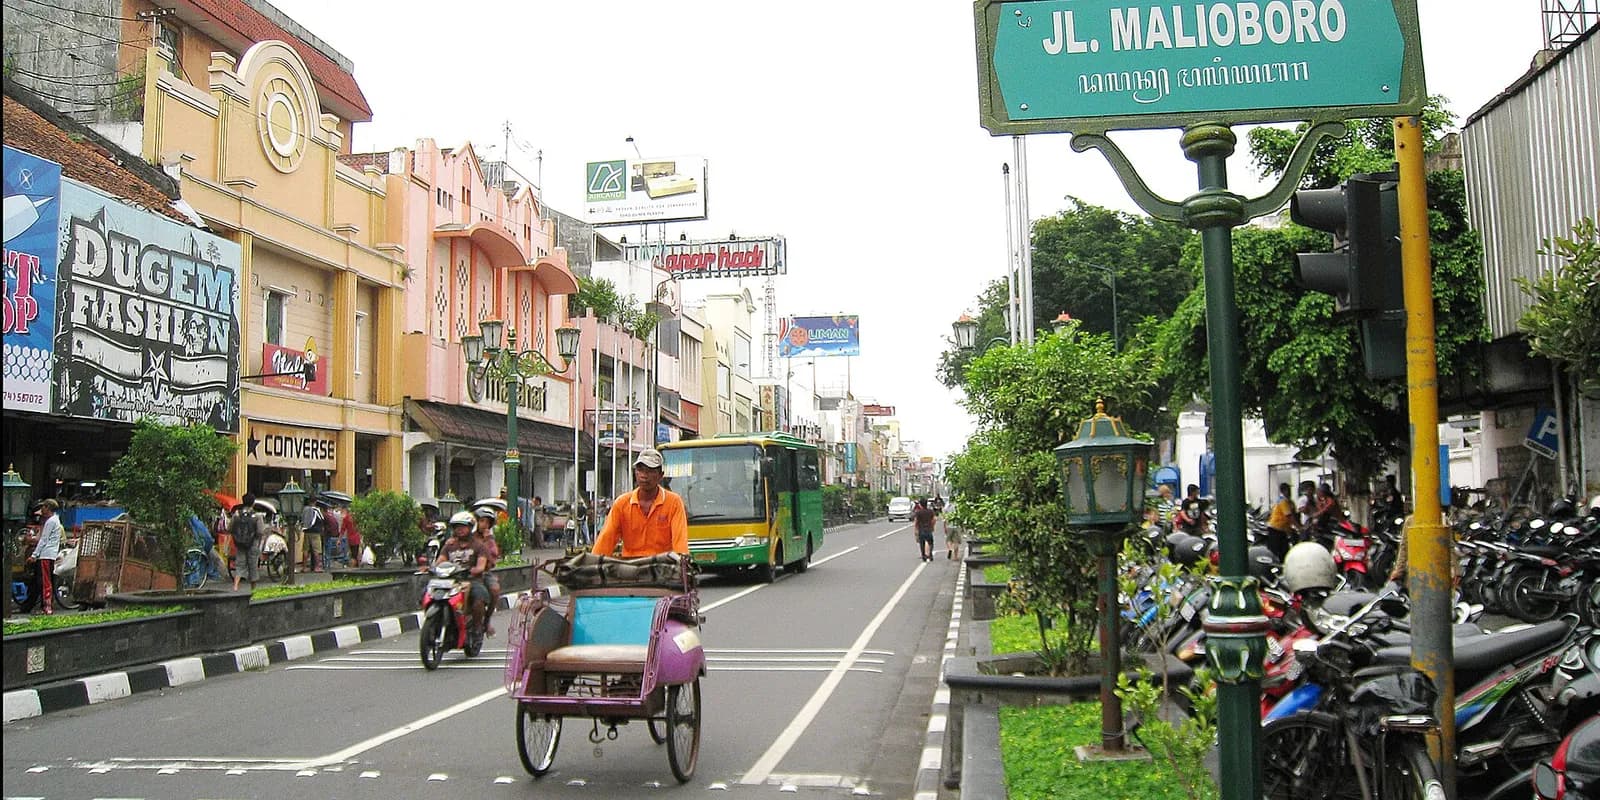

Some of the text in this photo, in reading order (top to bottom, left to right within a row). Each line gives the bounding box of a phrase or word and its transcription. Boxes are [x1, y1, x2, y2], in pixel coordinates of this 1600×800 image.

[1042, 0, 1347, 55] JL. MALIOBORO
[72, 224, 232, 314] DUGEM
[663, 253, 716, 272] anar
[485, 374, 548, 413] maahari
[1537, 415, 1560, 440] P
[264, 434, 335, 460] CONVERSE
